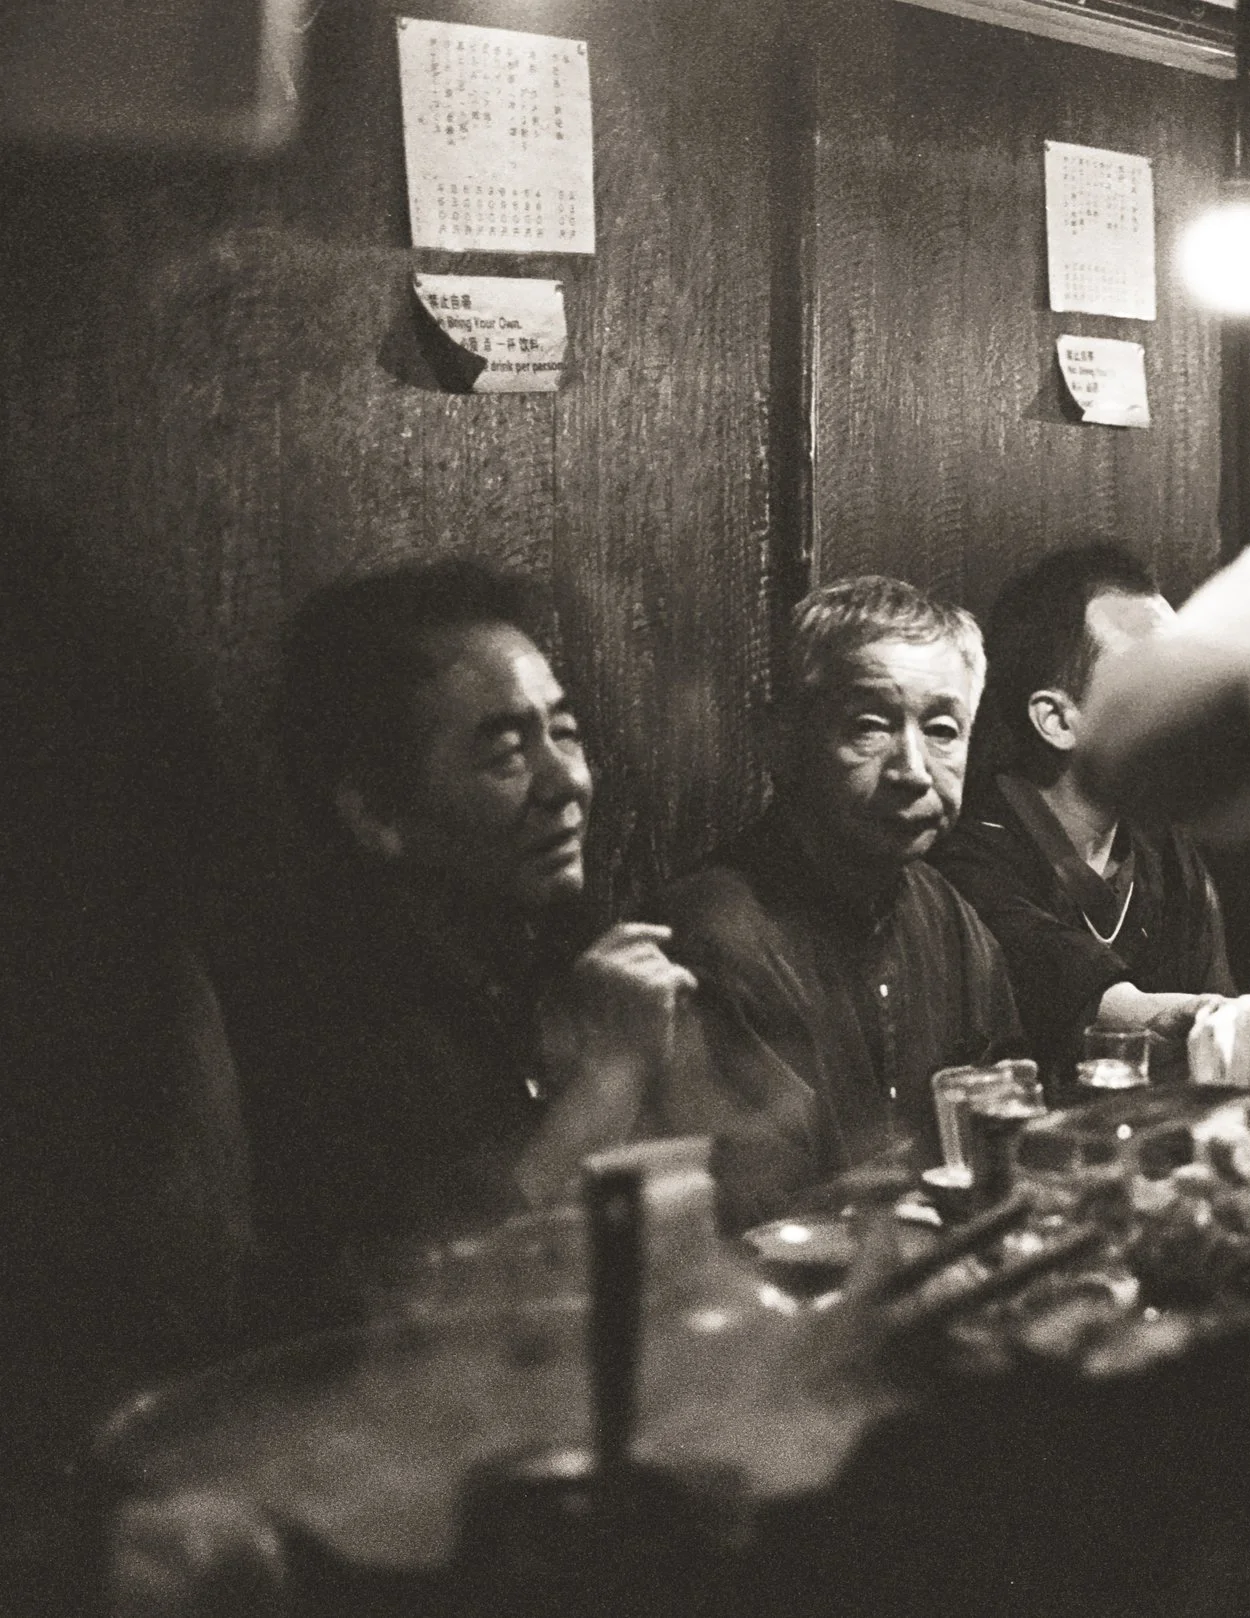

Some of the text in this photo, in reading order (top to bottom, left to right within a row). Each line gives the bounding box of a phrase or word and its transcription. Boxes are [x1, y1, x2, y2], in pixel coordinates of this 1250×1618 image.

[446, 315, 471, 332] Bring
[474, 316, 495, 329] Your
[490, 360, 513, 372] drink
[515, 362, 529, 375] per
